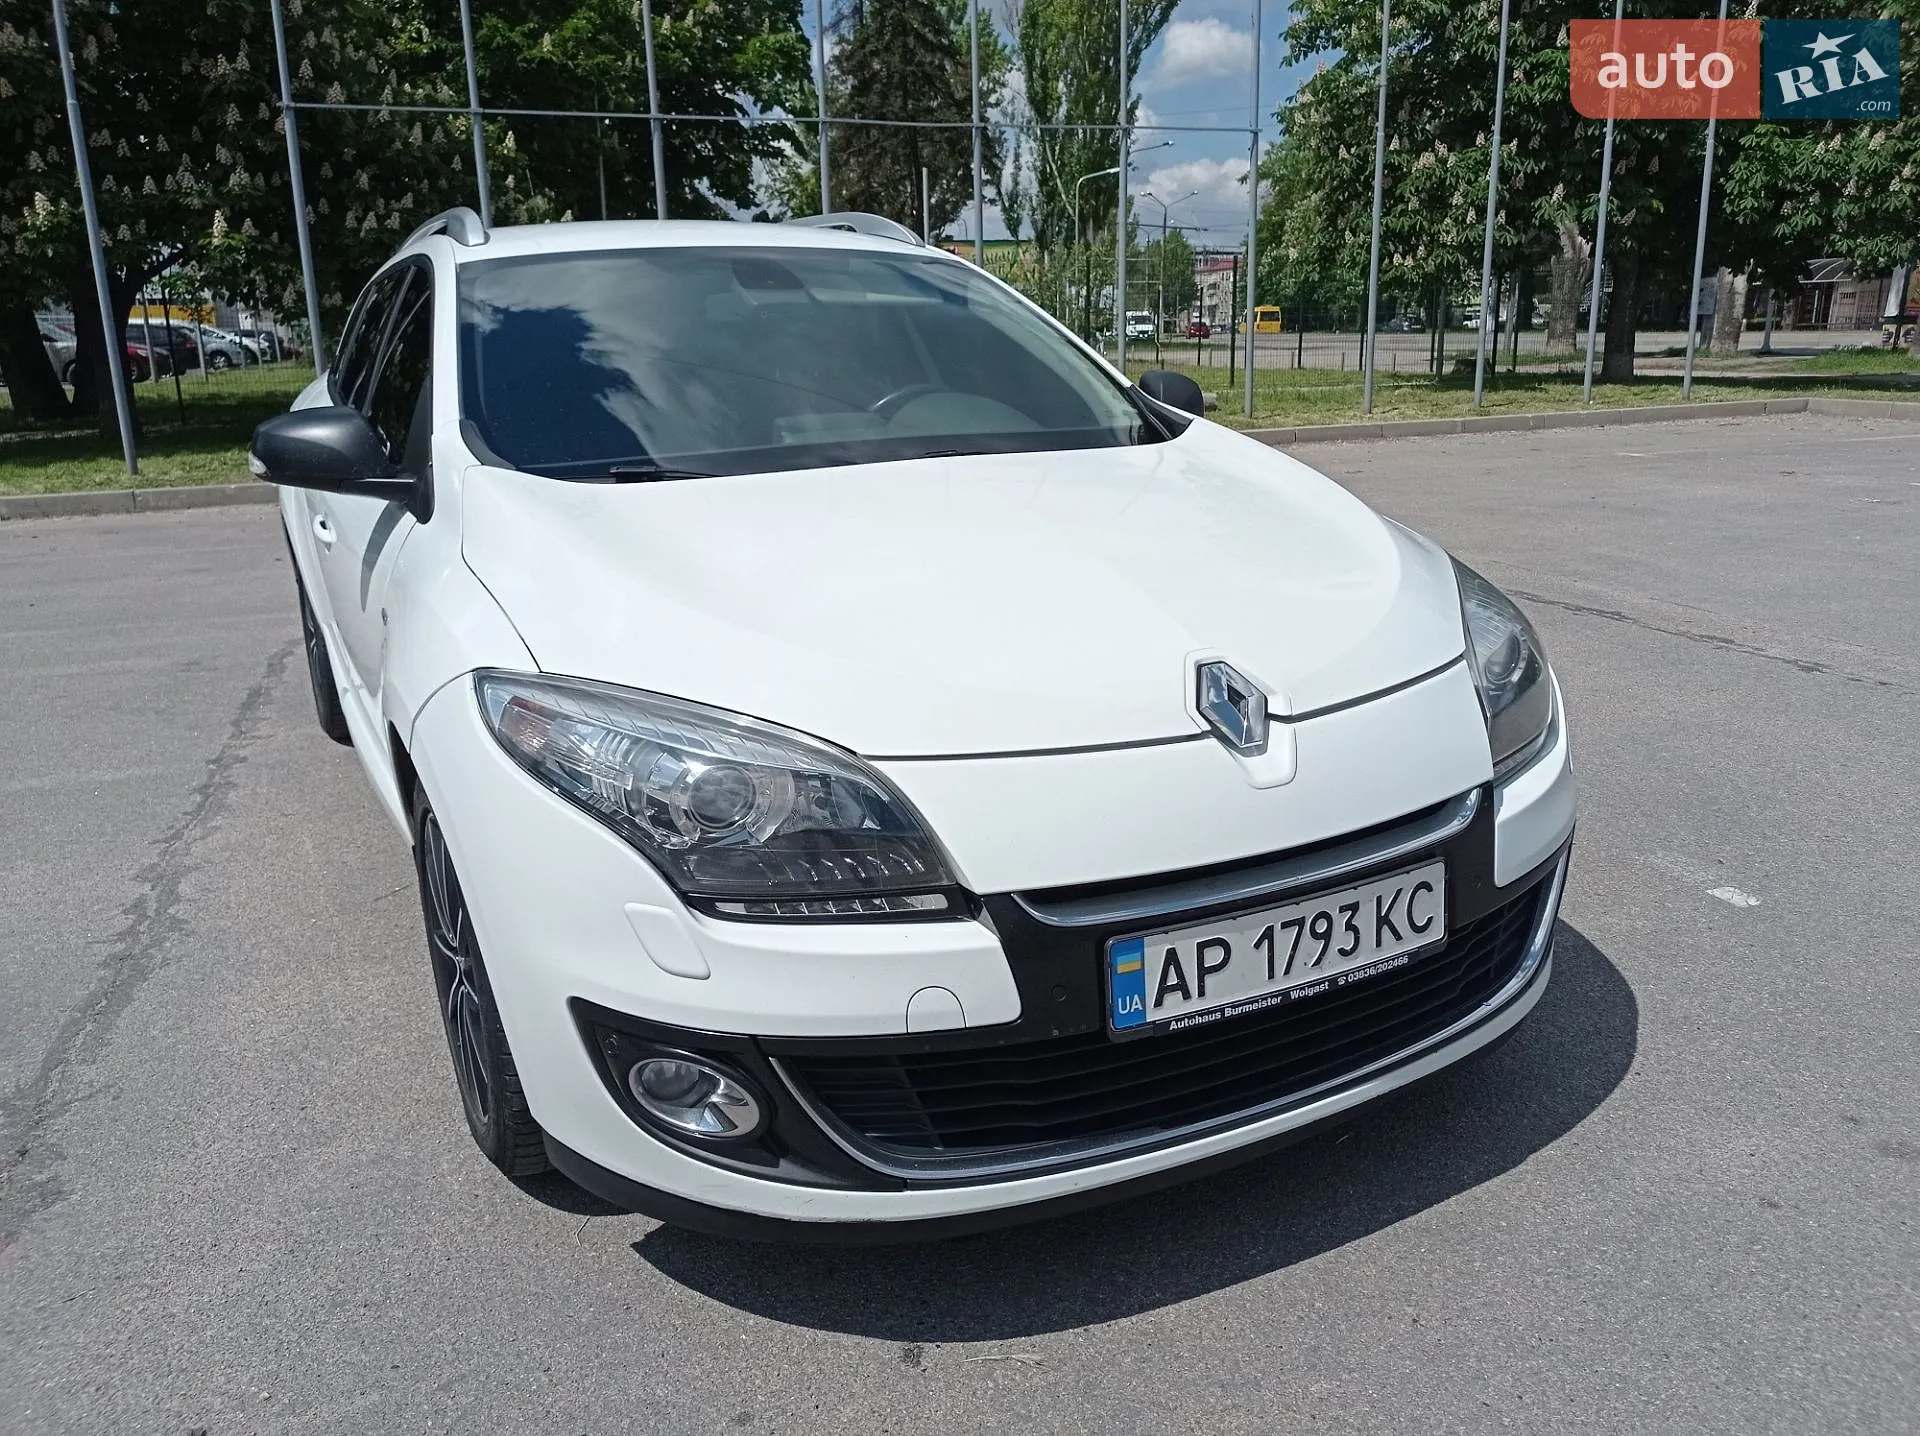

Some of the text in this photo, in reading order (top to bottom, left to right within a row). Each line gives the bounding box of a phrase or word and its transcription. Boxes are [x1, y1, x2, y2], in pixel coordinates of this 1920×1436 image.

[1152, 881, 1434, 1008] AP 1793 KC
[1117, 994, 1144, 1015] UA
[1169, 1011, 1221, 1031] Autohaus
[1225, 995, 1282, 1017] Burmeister
[1290, 982, 1329, 1000] Wolgast
